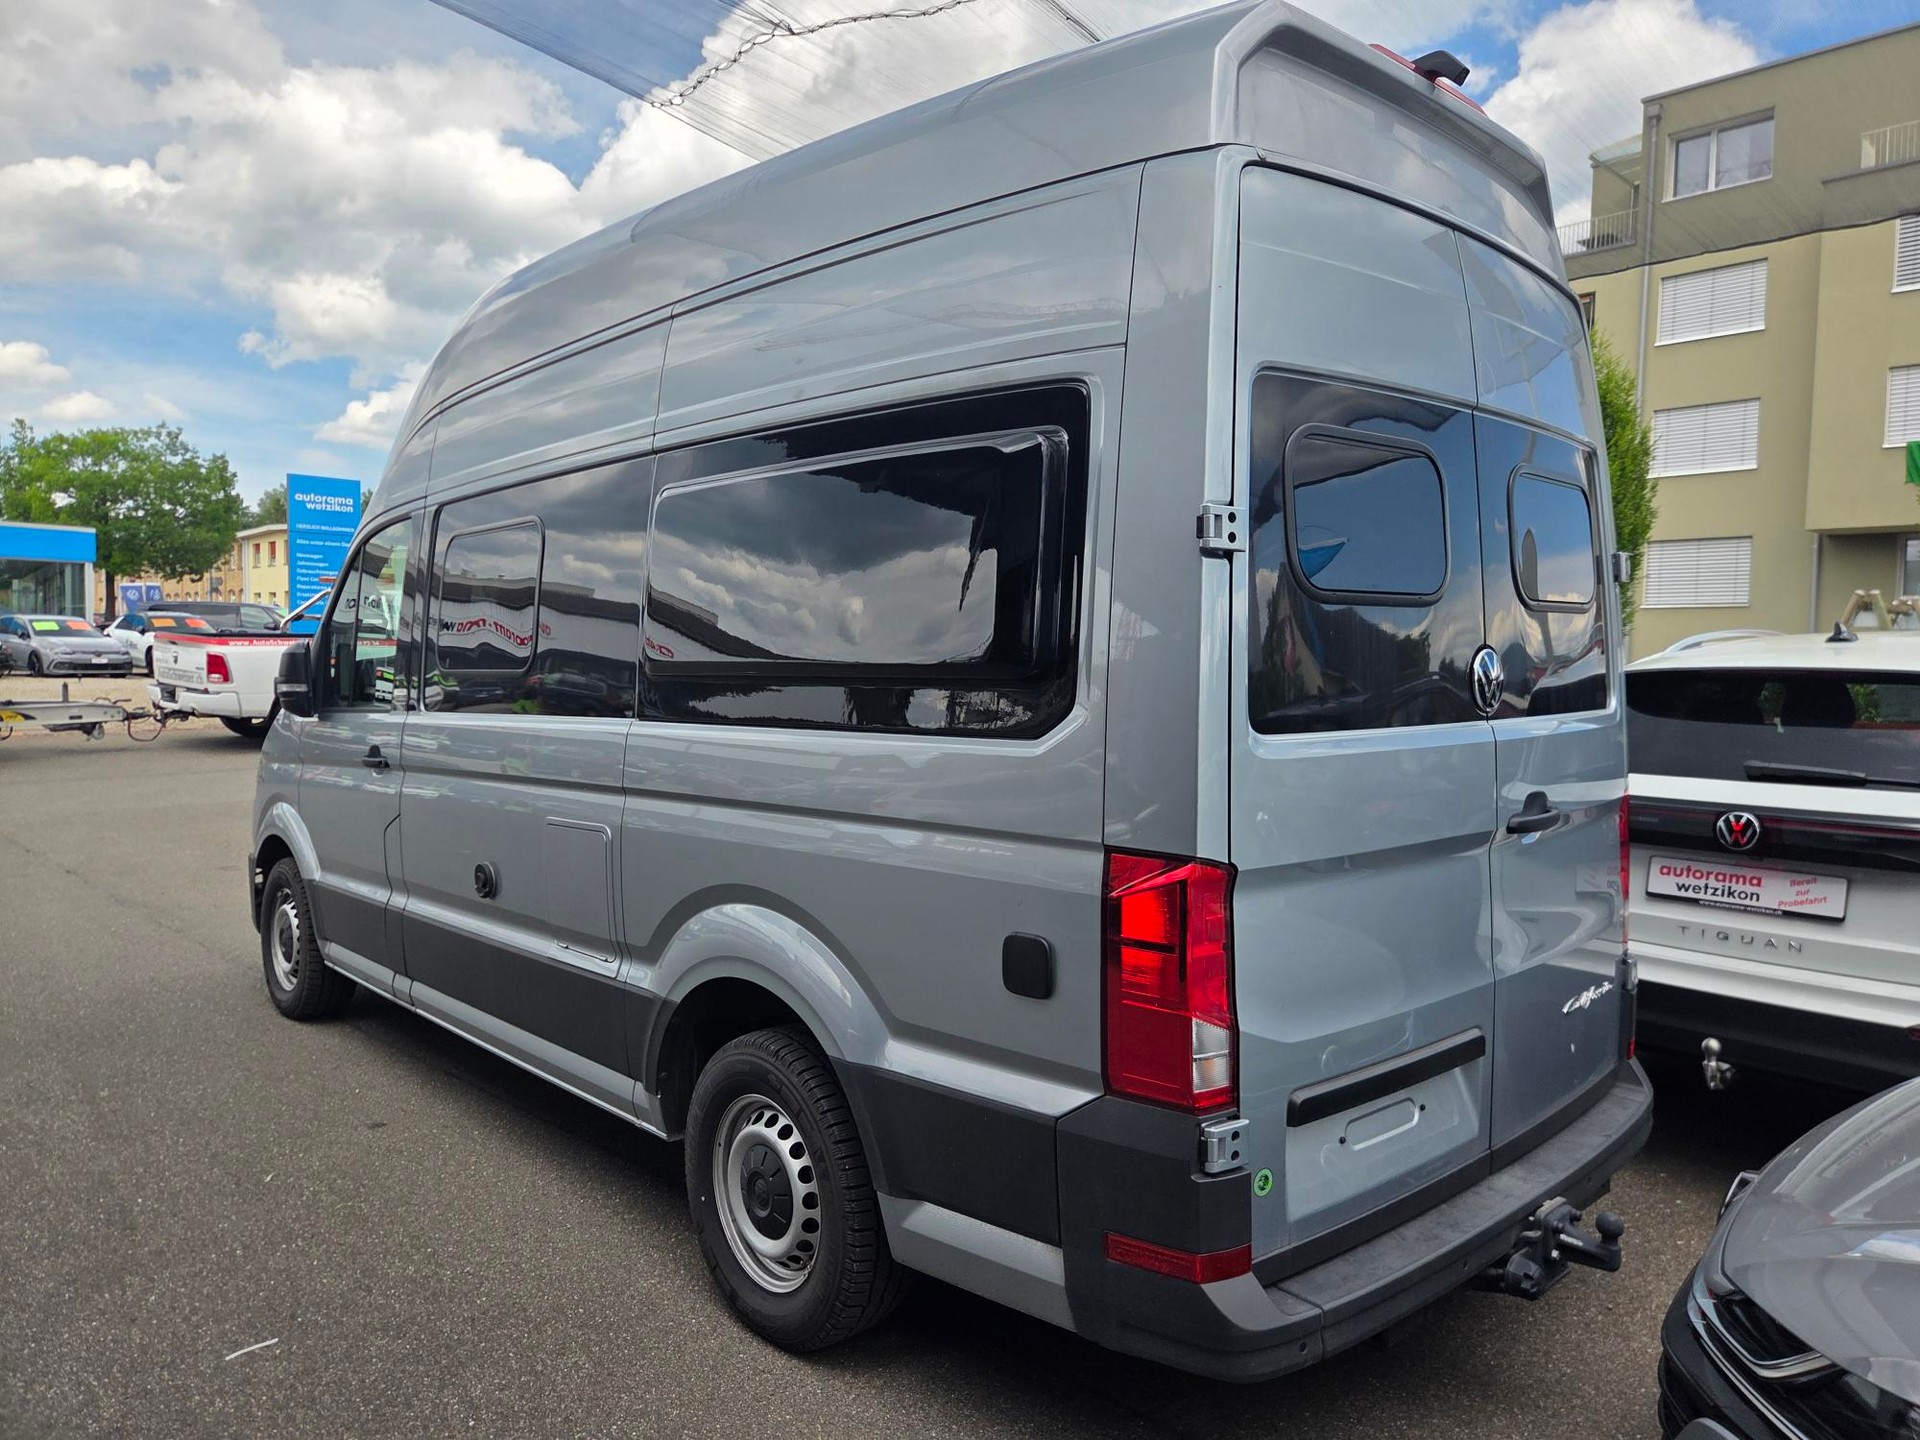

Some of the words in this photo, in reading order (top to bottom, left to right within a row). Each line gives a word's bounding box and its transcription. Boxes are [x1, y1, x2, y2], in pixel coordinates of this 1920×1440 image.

[294, 493, 354, 505] autorama
[305, 502, 354, 513] wetzikon
[1659, 863, 1763, 888] autorama
[1789, 877, 1818, 888] Bereit
[1675, 882, 1761, 903] wetzikon
[1795, 889, 1810, 897] zur
[1778, 896, 1828, 909] Probefahrt
[1677, 925, 1803, 953] TIGUAN
